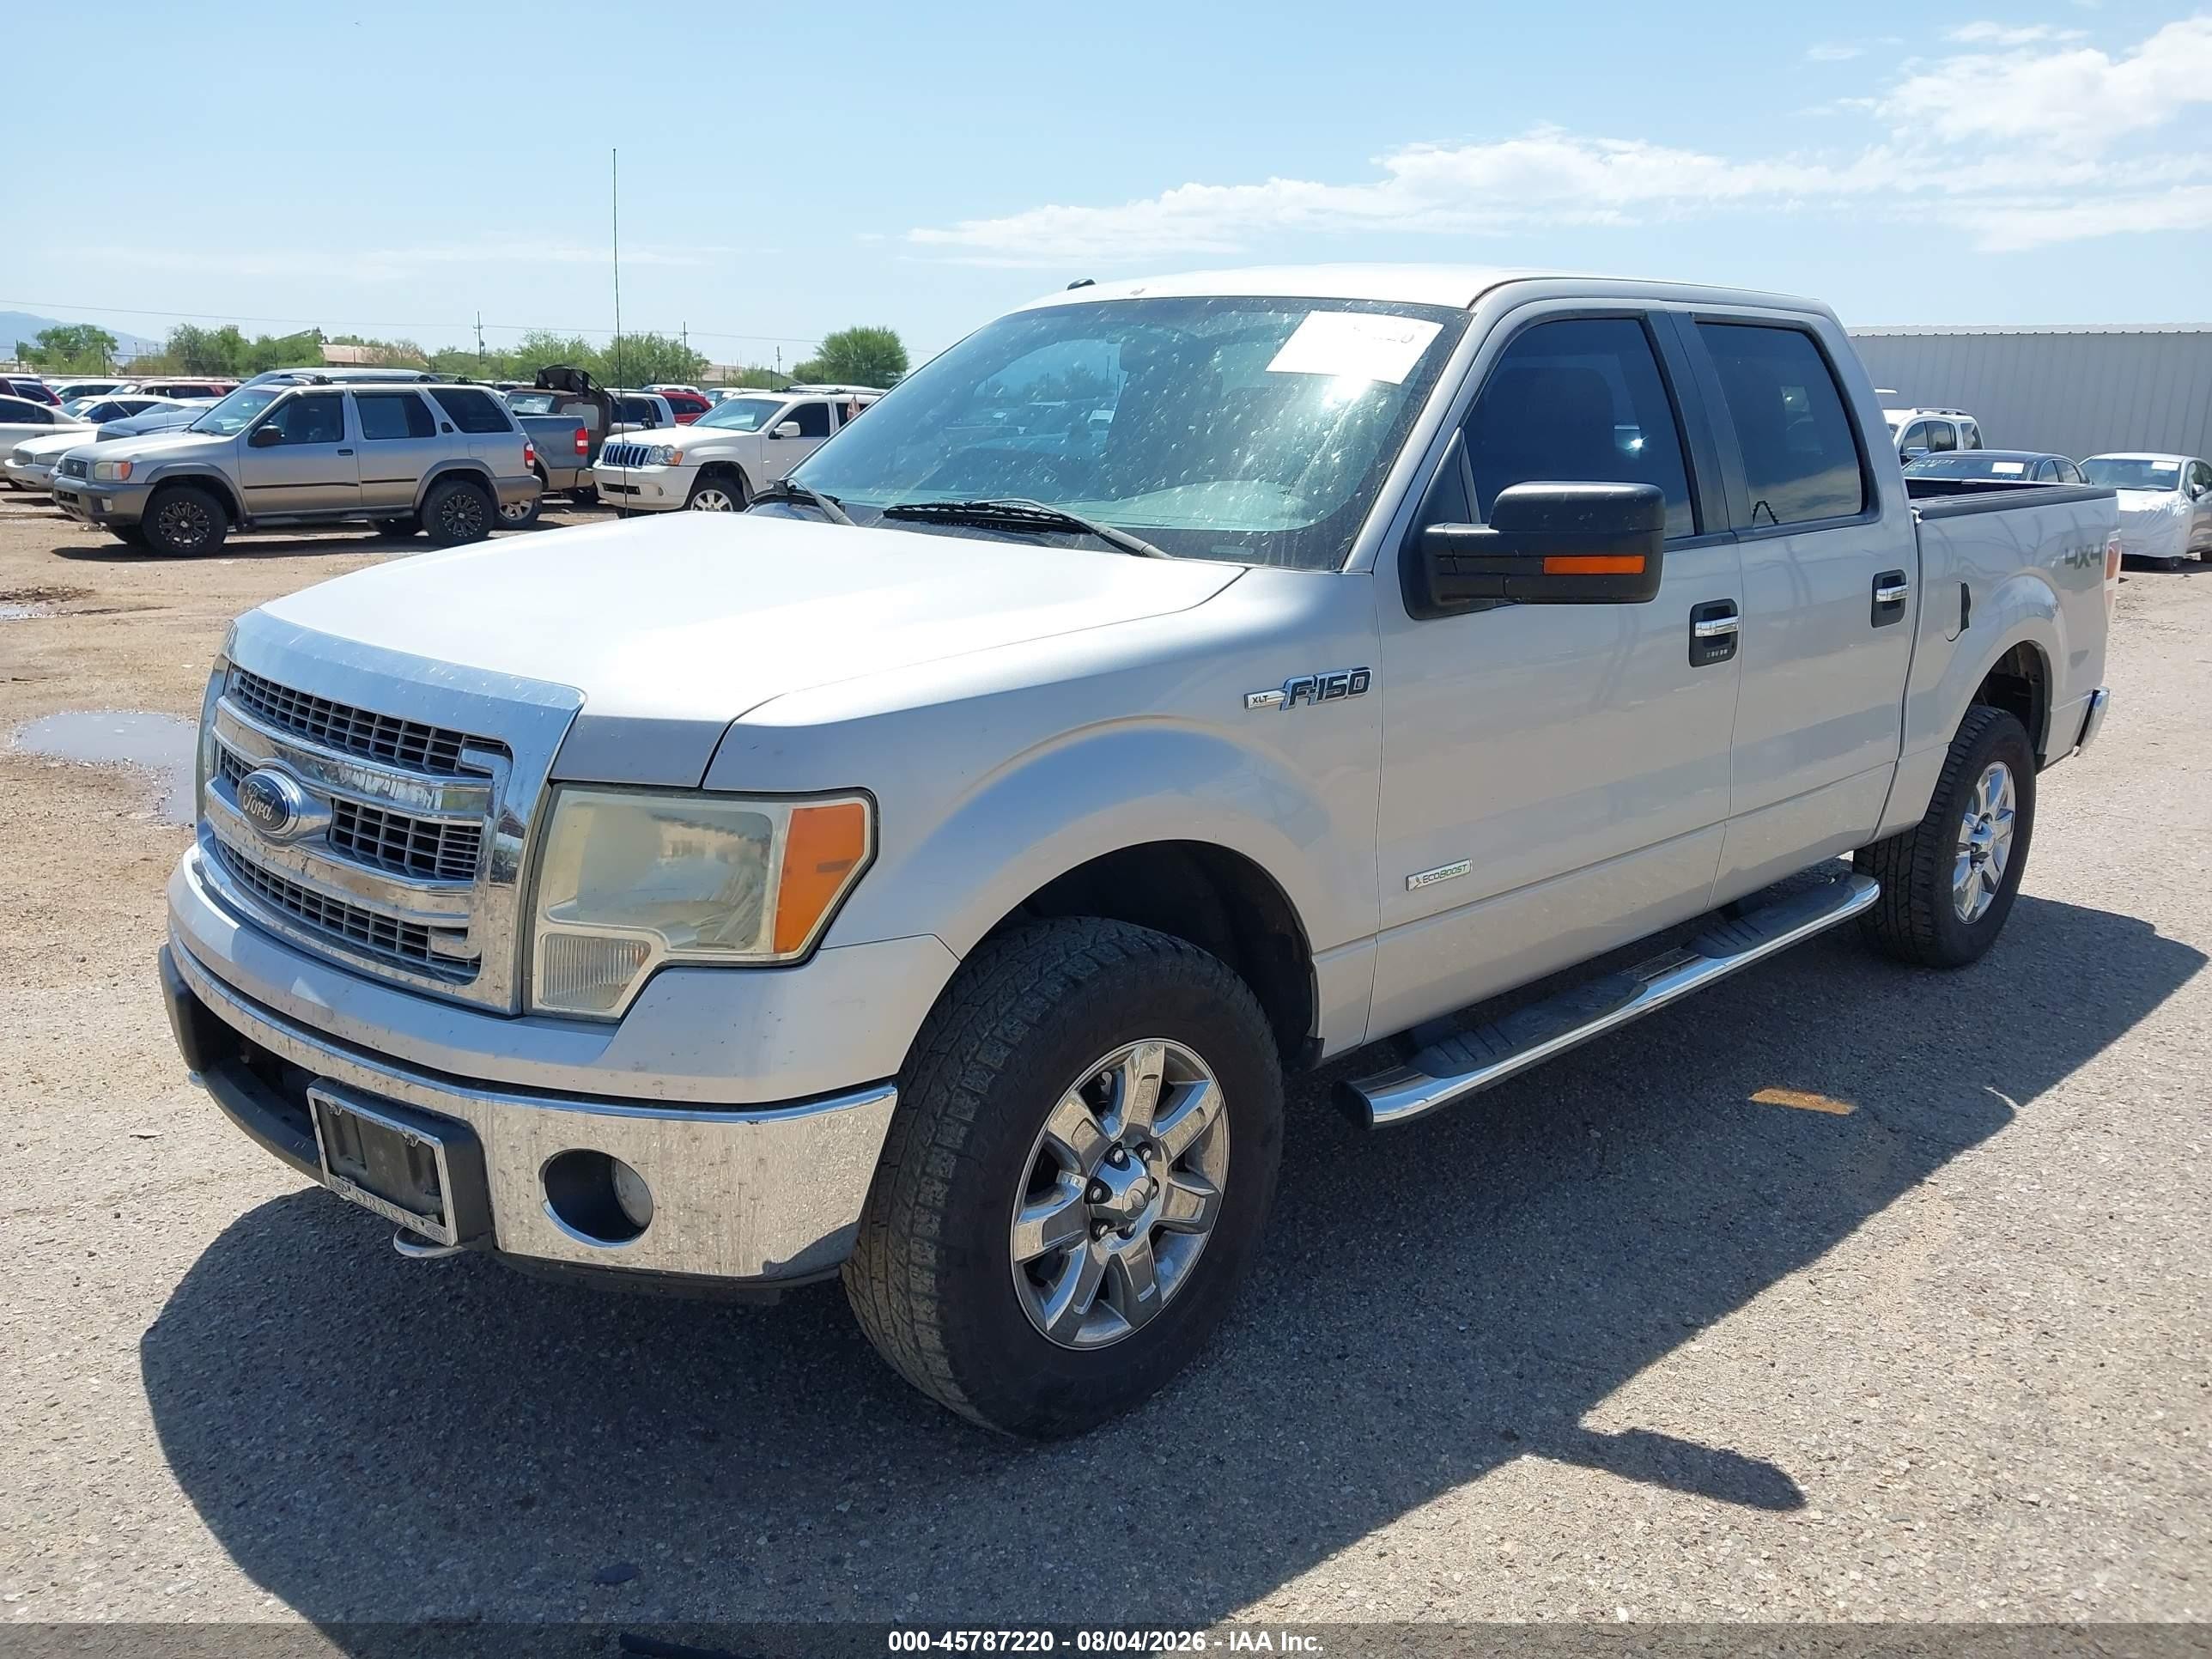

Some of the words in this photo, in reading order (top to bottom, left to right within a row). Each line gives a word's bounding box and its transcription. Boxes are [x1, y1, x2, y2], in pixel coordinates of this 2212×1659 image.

[1252, 695, 1269, 705] XLT
[1279, 666, 1373, 711] F-150
[242, 781, 276, 822] Ford
[355, 1191, 420, 1231] ORACLE
